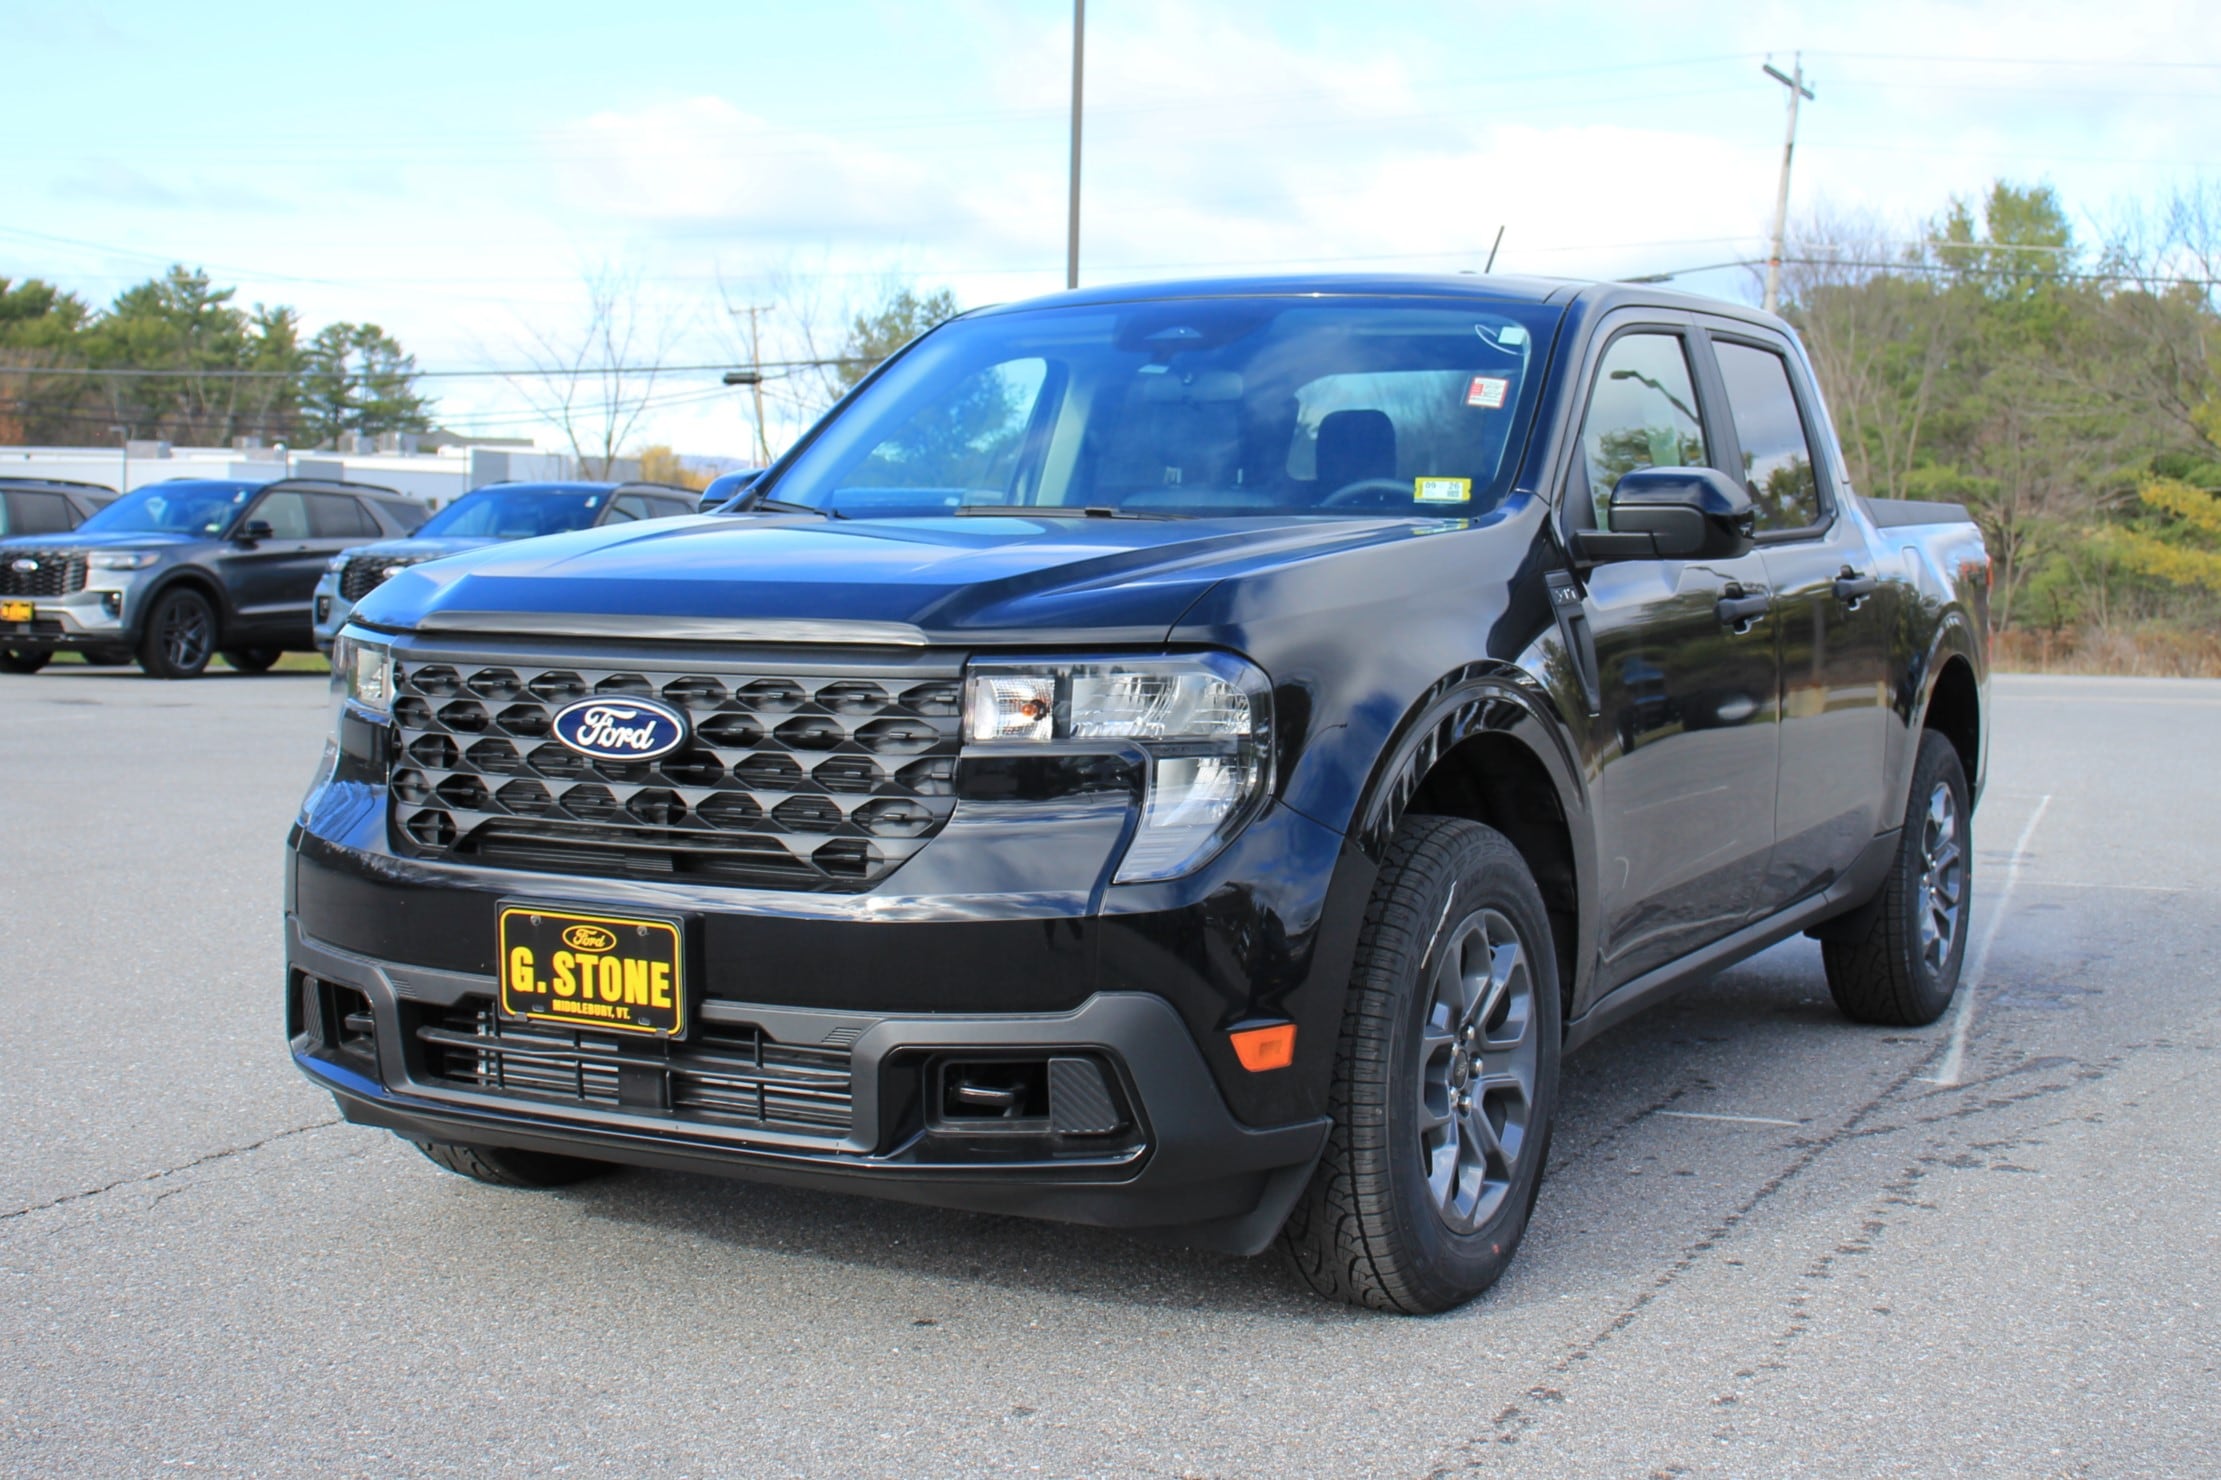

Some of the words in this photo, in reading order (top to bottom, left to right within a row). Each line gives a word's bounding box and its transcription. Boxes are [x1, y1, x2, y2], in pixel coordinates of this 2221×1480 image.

[576, 706, 657, 750] Ford
[573, 928, 605, 947] Ford
[511, 946, 547, 994] G.
[553, 951, 672, 1008] STONE
[552, 999, 615, 1019] MIDDLEBURY,
[615, 1006, 631, 1020] VT.
